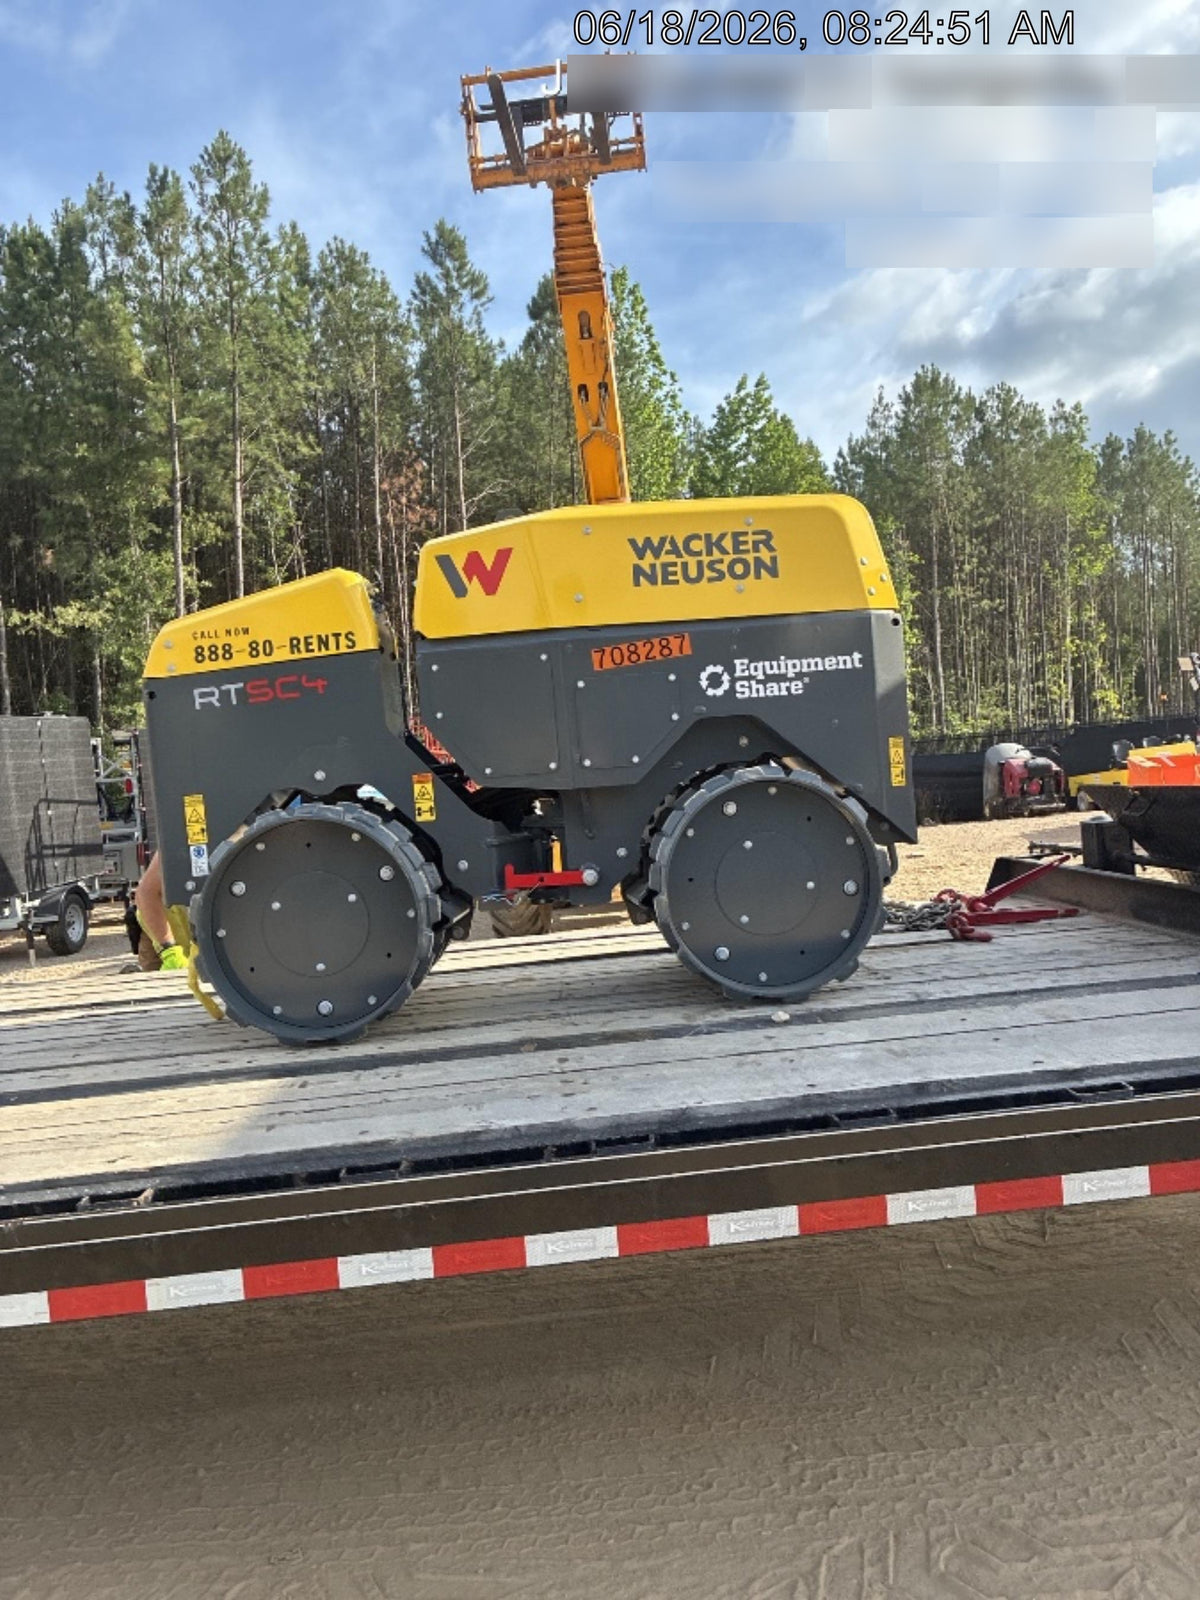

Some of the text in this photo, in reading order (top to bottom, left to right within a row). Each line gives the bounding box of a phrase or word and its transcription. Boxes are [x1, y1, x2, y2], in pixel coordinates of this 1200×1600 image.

[627, 529, 777, 561] WACKER
[632, 555, 780, 587] NEUSON
[192, 627, 250, 641] CALL NOW
[593, 634, 687, 669] 708287
[733, 651, 863, 680] Equipment
